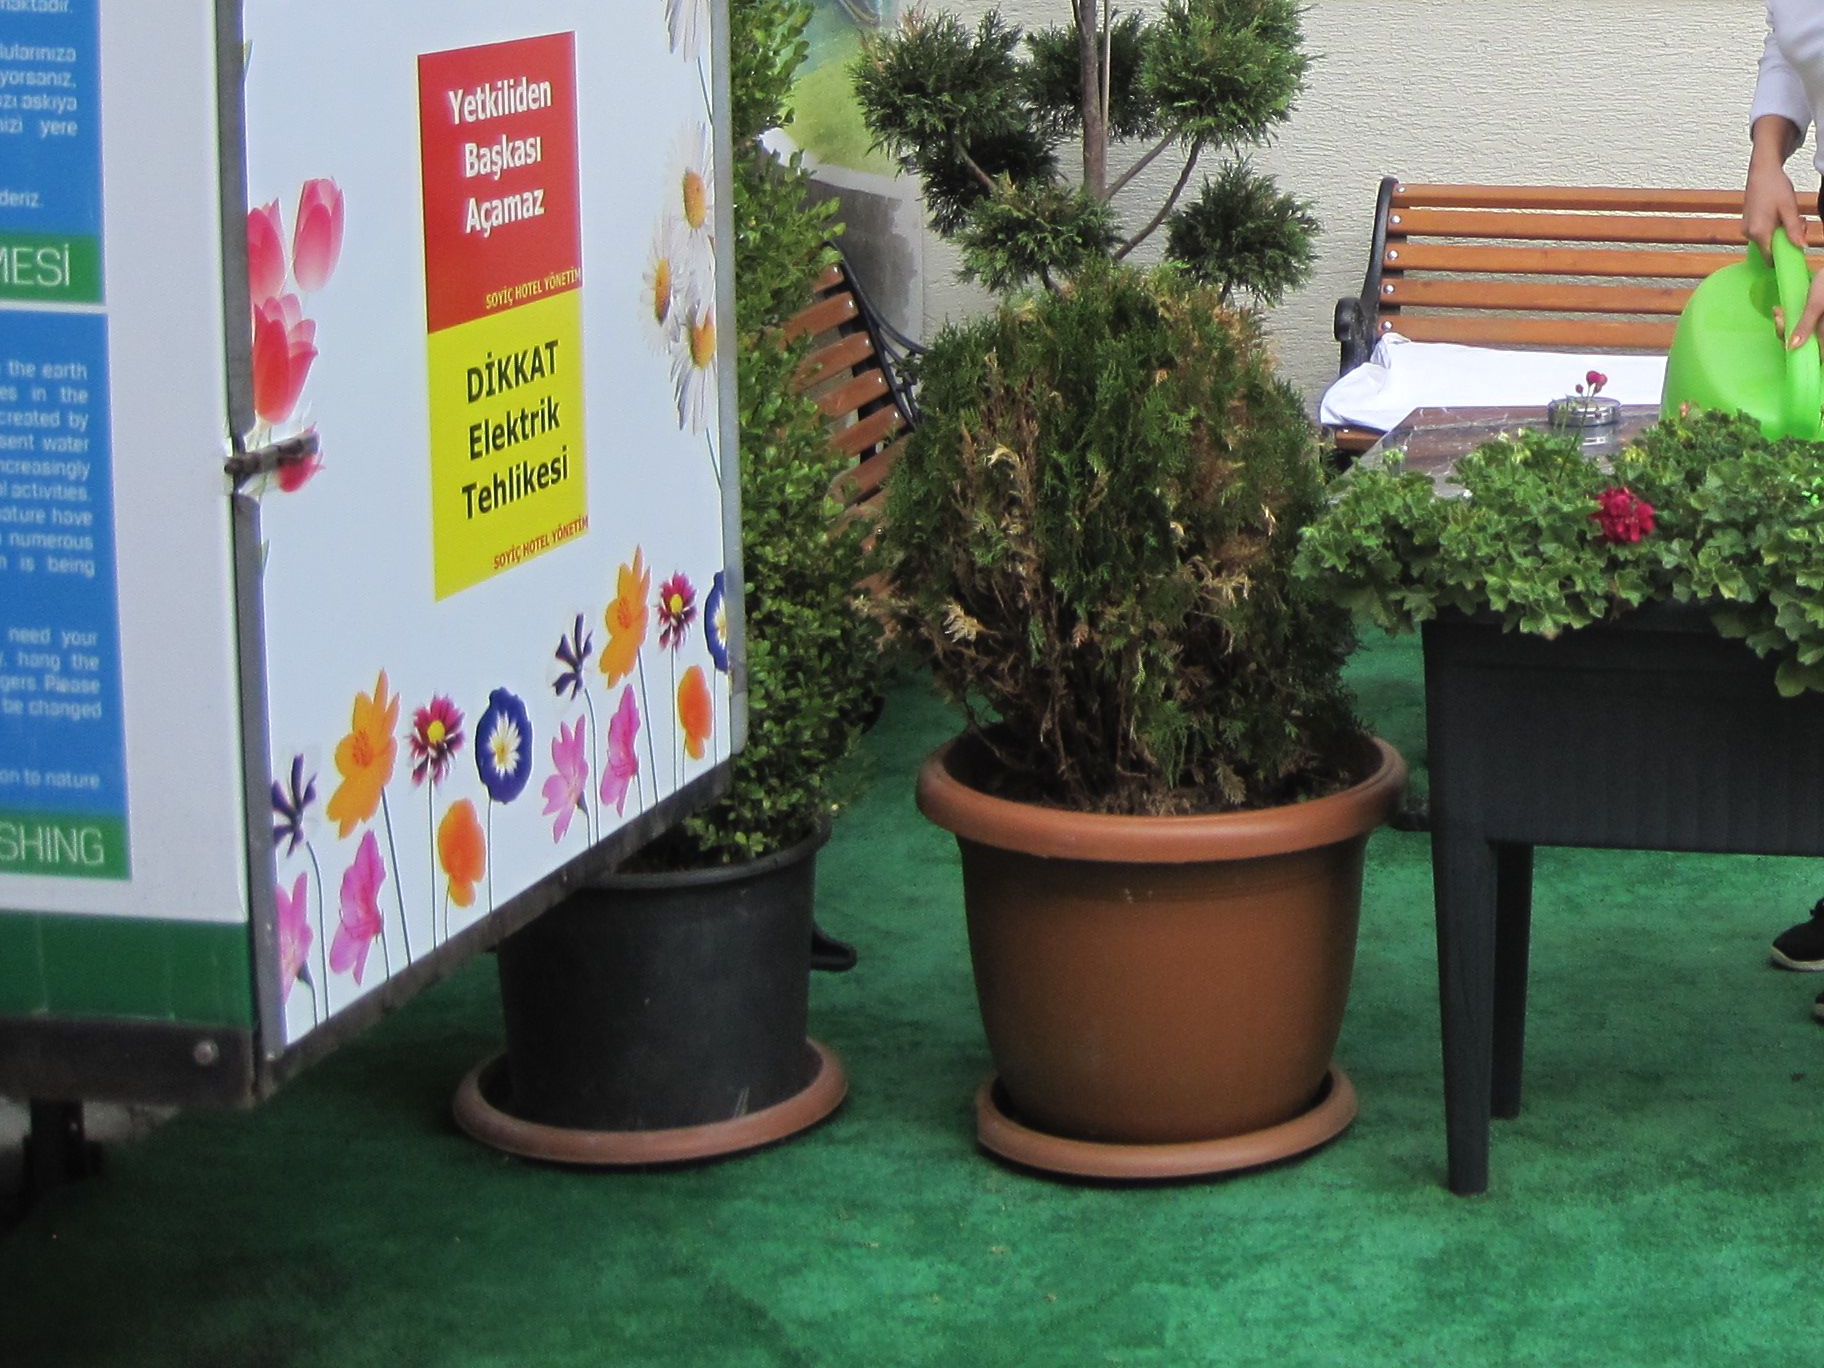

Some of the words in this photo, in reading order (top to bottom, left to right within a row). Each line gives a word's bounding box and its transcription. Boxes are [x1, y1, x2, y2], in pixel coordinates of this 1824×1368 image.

[21, 93, 77, 114] askıya
[448, 76, 552, 125] Yetkiliden
[40, 120, 78, 138] yere
[464, 134, 543, 181] Başkası
[465, 189, 546, 239] Açamaz
[485, 286, 514, 310] SOYİÇ
[515, 279, 543, 301] HOTEL
[8, 360, 36, 378] the
[42, 363, 88, 380] earth
[466, 339, 559, 404] DİKKAT
[31, 385, 47, 402] in
[60, 387, 88, 405] the
[68, 412, 89, 432] by
[469, 396, 560, 460] Elektrik
[42, 436, 89, 452] water
[461, 445, 569, 519] Tehlikesi
[52, 507, 93, 527] have
[9, 533, 94, 550] numerous
[523, 534, 550, 557] HOTEL
[47, 556, 95, 578] being
[61, 631, 98, 648] your
[17, 651, 61, 671] hang
[71, 653, 99, 671] the
[44, 674, 100, 694] Please
[28, 700, 102, 721] changed
